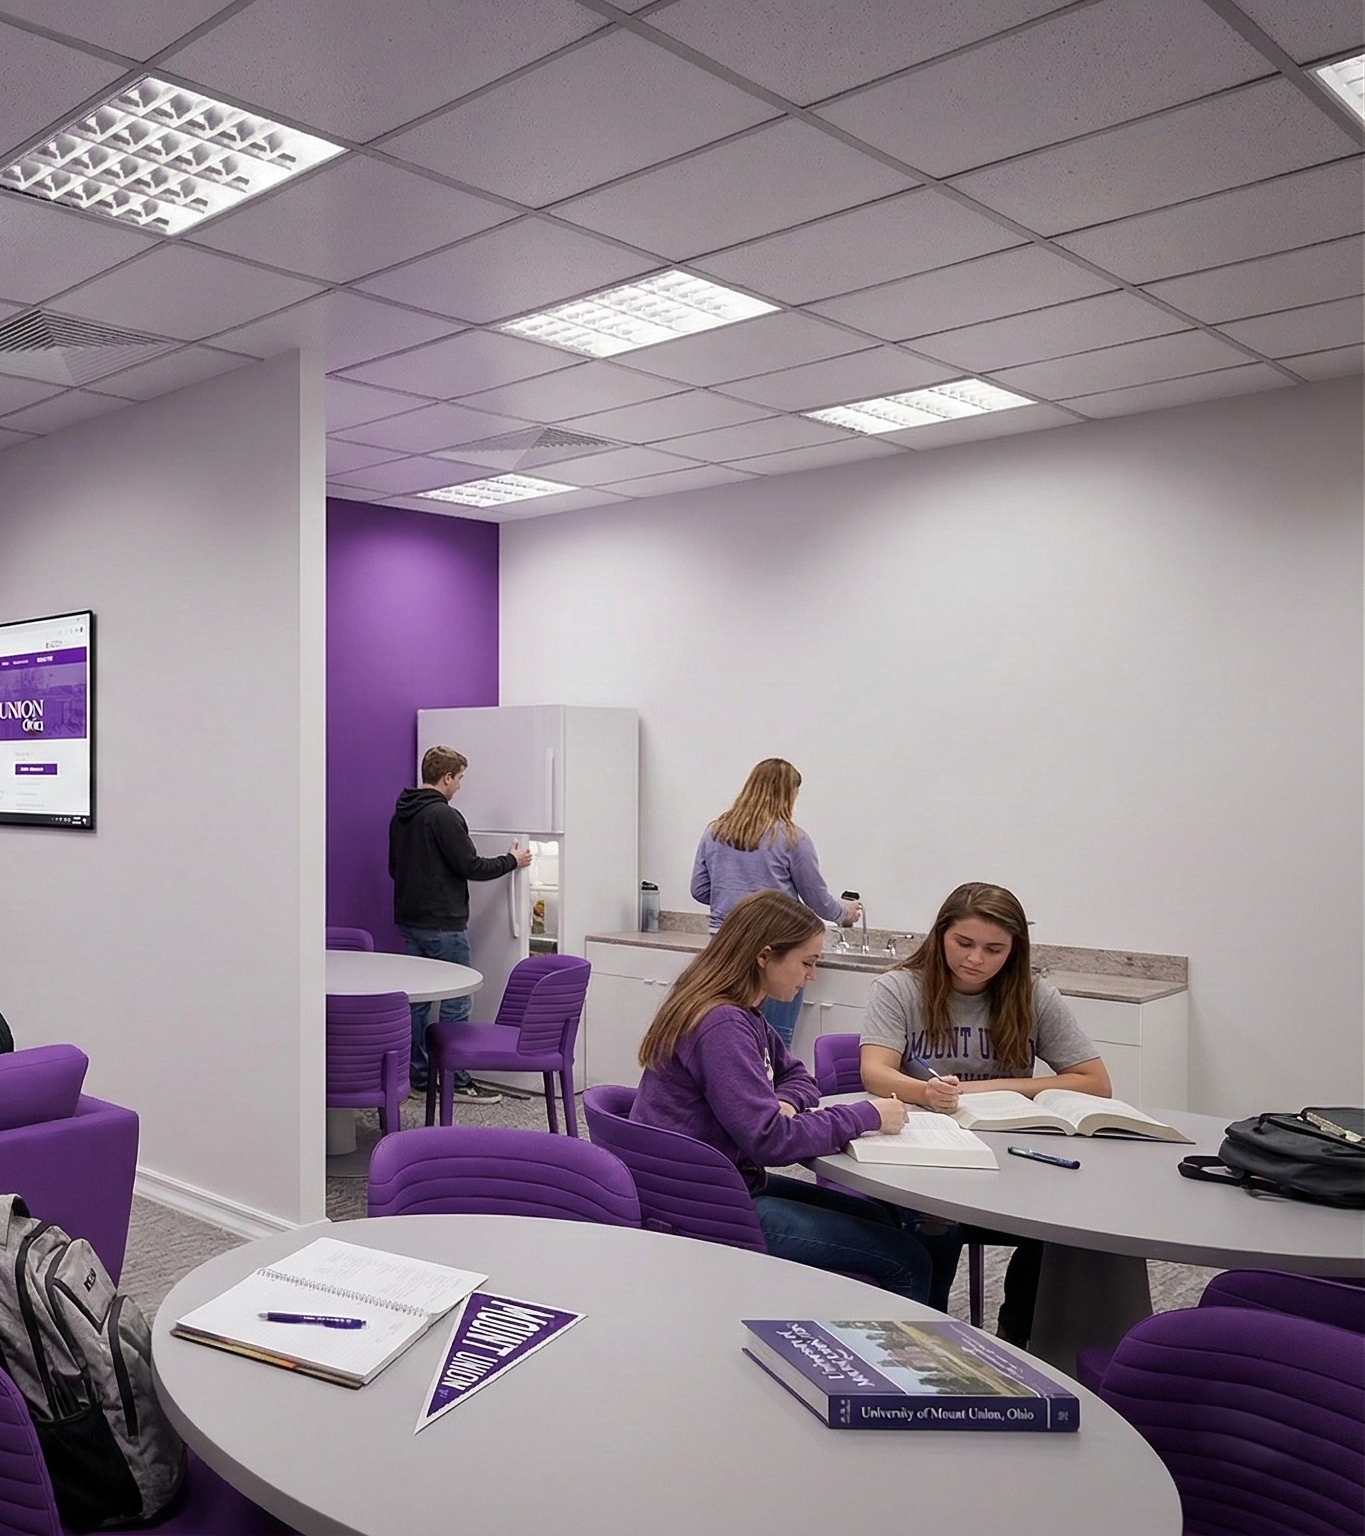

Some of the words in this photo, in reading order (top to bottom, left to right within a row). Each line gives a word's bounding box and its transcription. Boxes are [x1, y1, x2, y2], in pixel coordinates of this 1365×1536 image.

[0, 700, 44, 720] UNION
[461, 1299, 556, 1357] MOUNT
[440, 1350, 499, 1391] UNION
[1006, 1407, 1035, 1420] Ohio
